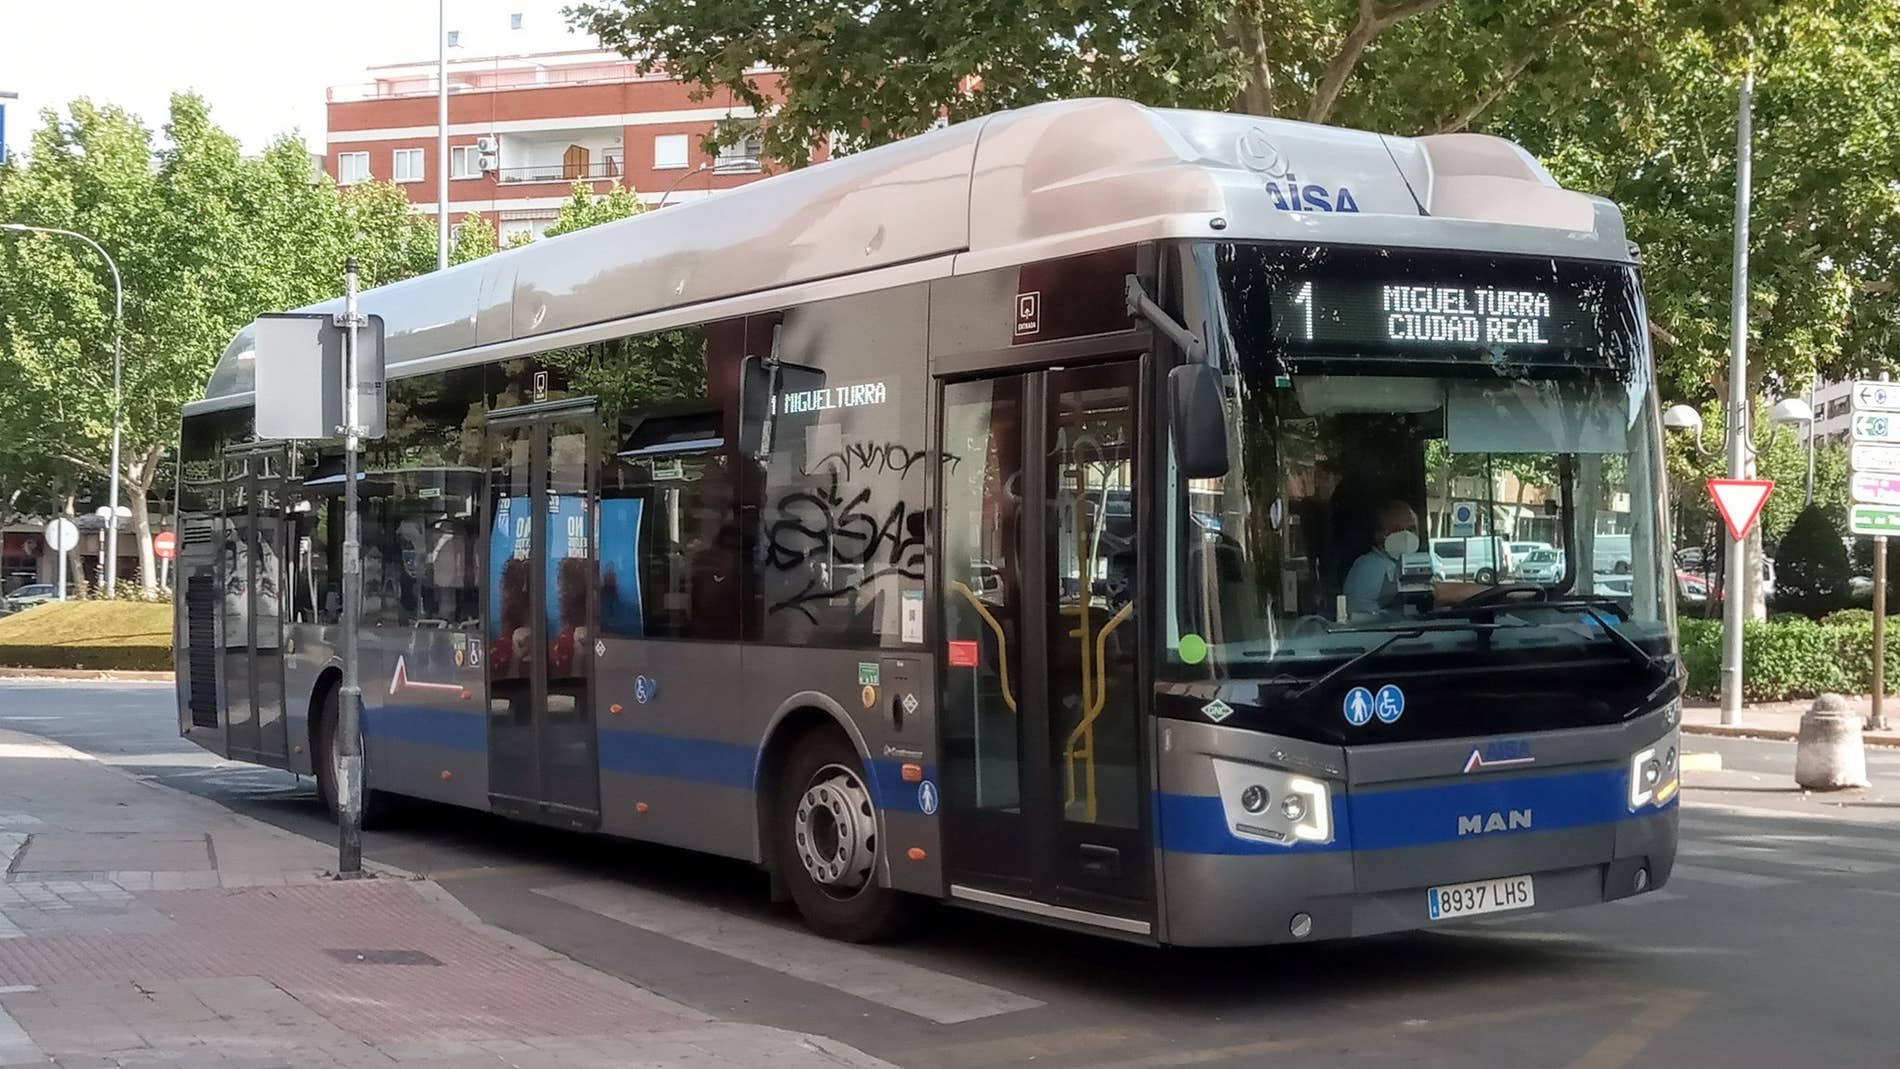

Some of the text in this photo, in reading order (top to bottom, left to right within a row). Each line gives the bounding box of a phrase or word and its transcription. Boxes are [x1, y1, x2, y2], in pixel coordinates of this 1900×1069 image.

[1294, 281, 1313, 340] 1
[1383, 285, 1550, 317] MIGUELTURRA
[1388, 313, 1549, 344] CIUDAD REAL
[784, 382, 886, 414] MIGUELTURRA
[1458, 809, 1532, 835] MAN
[1441, 880, 1528, 913] 8937 LHS
